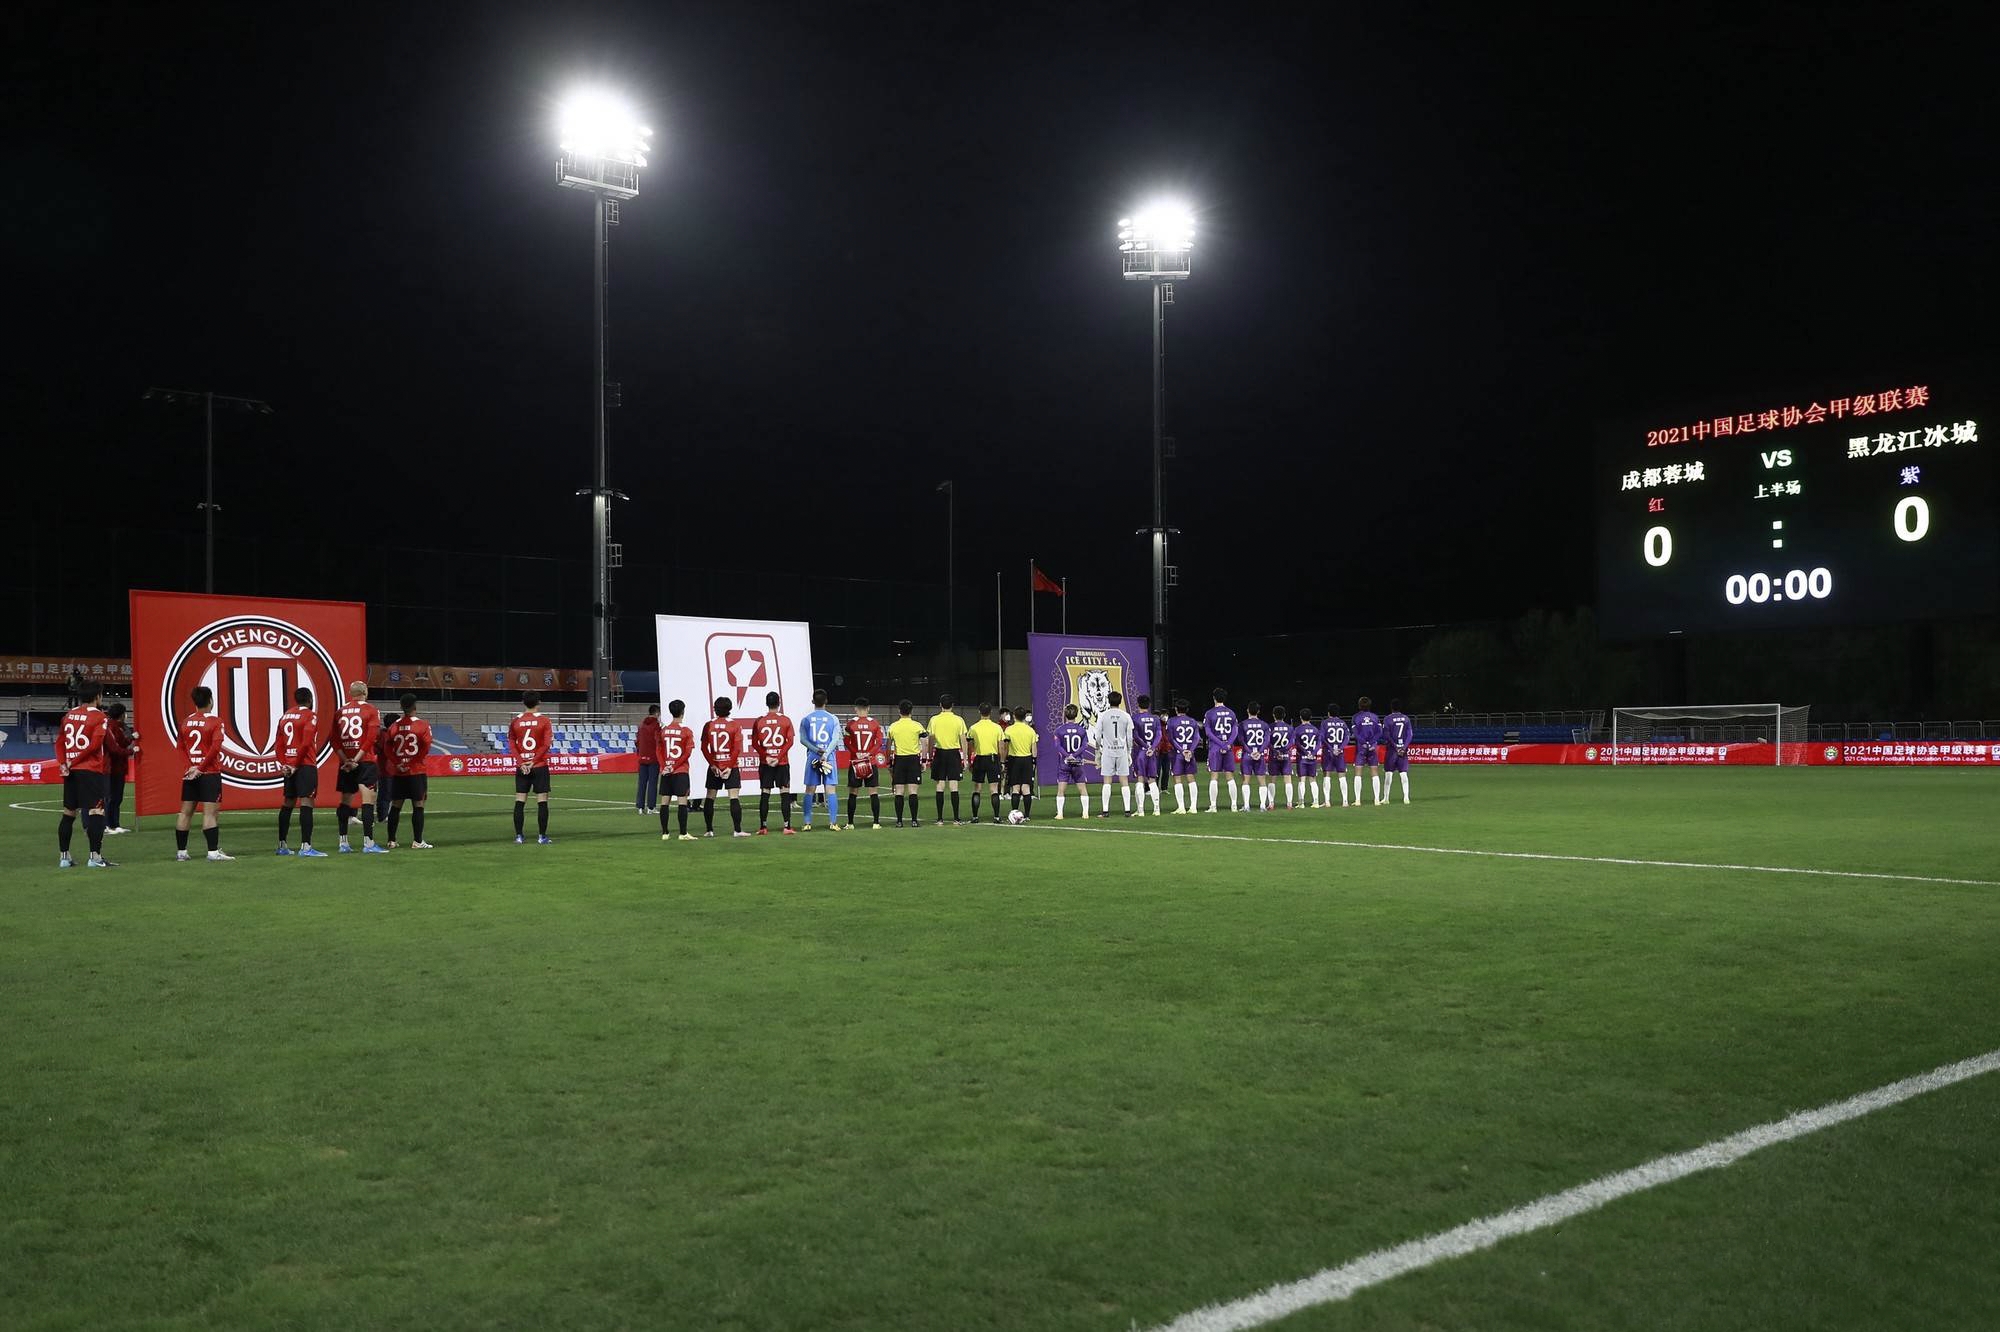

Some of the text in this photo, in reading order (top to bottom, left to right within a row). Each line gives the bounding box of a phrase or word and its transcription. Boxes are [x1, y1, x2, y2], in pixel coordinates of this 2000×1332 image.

[1647, 385, 1930, 447] 2021中国足球协会甲级联赛
[1847, 420, 1978, 459] 黑龙江冰城
[1761, 449, 1793, 469] VS
[1621, 461, 1705, 491] 成都蓉城
[1900, 466, 1921, 486] 紫
[1753, 480, 1801, 499] 上半场
[1648, 497, 1665, 513] 红
[1643, 526, 1672, 567] 0
[1893, 496, 1930, 542] 0
[1725, 567, 1832, 605] 00:00
[207, 629, 305, 657] CHENGDU
[1065, 656, 1081, 665] ICE
[1082, 656, 1102, 665] CITY
[283, 721, 295, 746] 9
[339, 715, 363, 739] 28
[810, 722, 829, 743] 16
[1112, 721, 1118, 739] 1
[1144, 723, 1154, 740] 5
[1175, 726, 1195, 743] 32
[1214, 717, 1232, 734] 45
[1327, 727, 1345, 743] 30
[1395, 722, 1405, 738] 7
[64, 723, 90, 750] 36
[189, 729, 202, 755] 2
[394, 733, 419, 756] 23
[522, 728, 537, 751] 6
[710, 731, 730, 752] 12
[760, 726, 785, 747] 26
[853, 731, 873, 751] 17
[1064, 734, 1082, 753] 10
[1246, 729, 1265, 746] 28
[1272, 732, 1289, 749] 26
[1301, 735, 1317, 750] 34
[664, 737, 682, 759] 15
[1407, 748, 1498, 756] 2021中国足球协会甲级联赛
[1600, 747, 1715, 756] 2021中国足球协会甲级联赛
[1843, 745, 1986, 755] 2021中国足球协会甲级联赛
